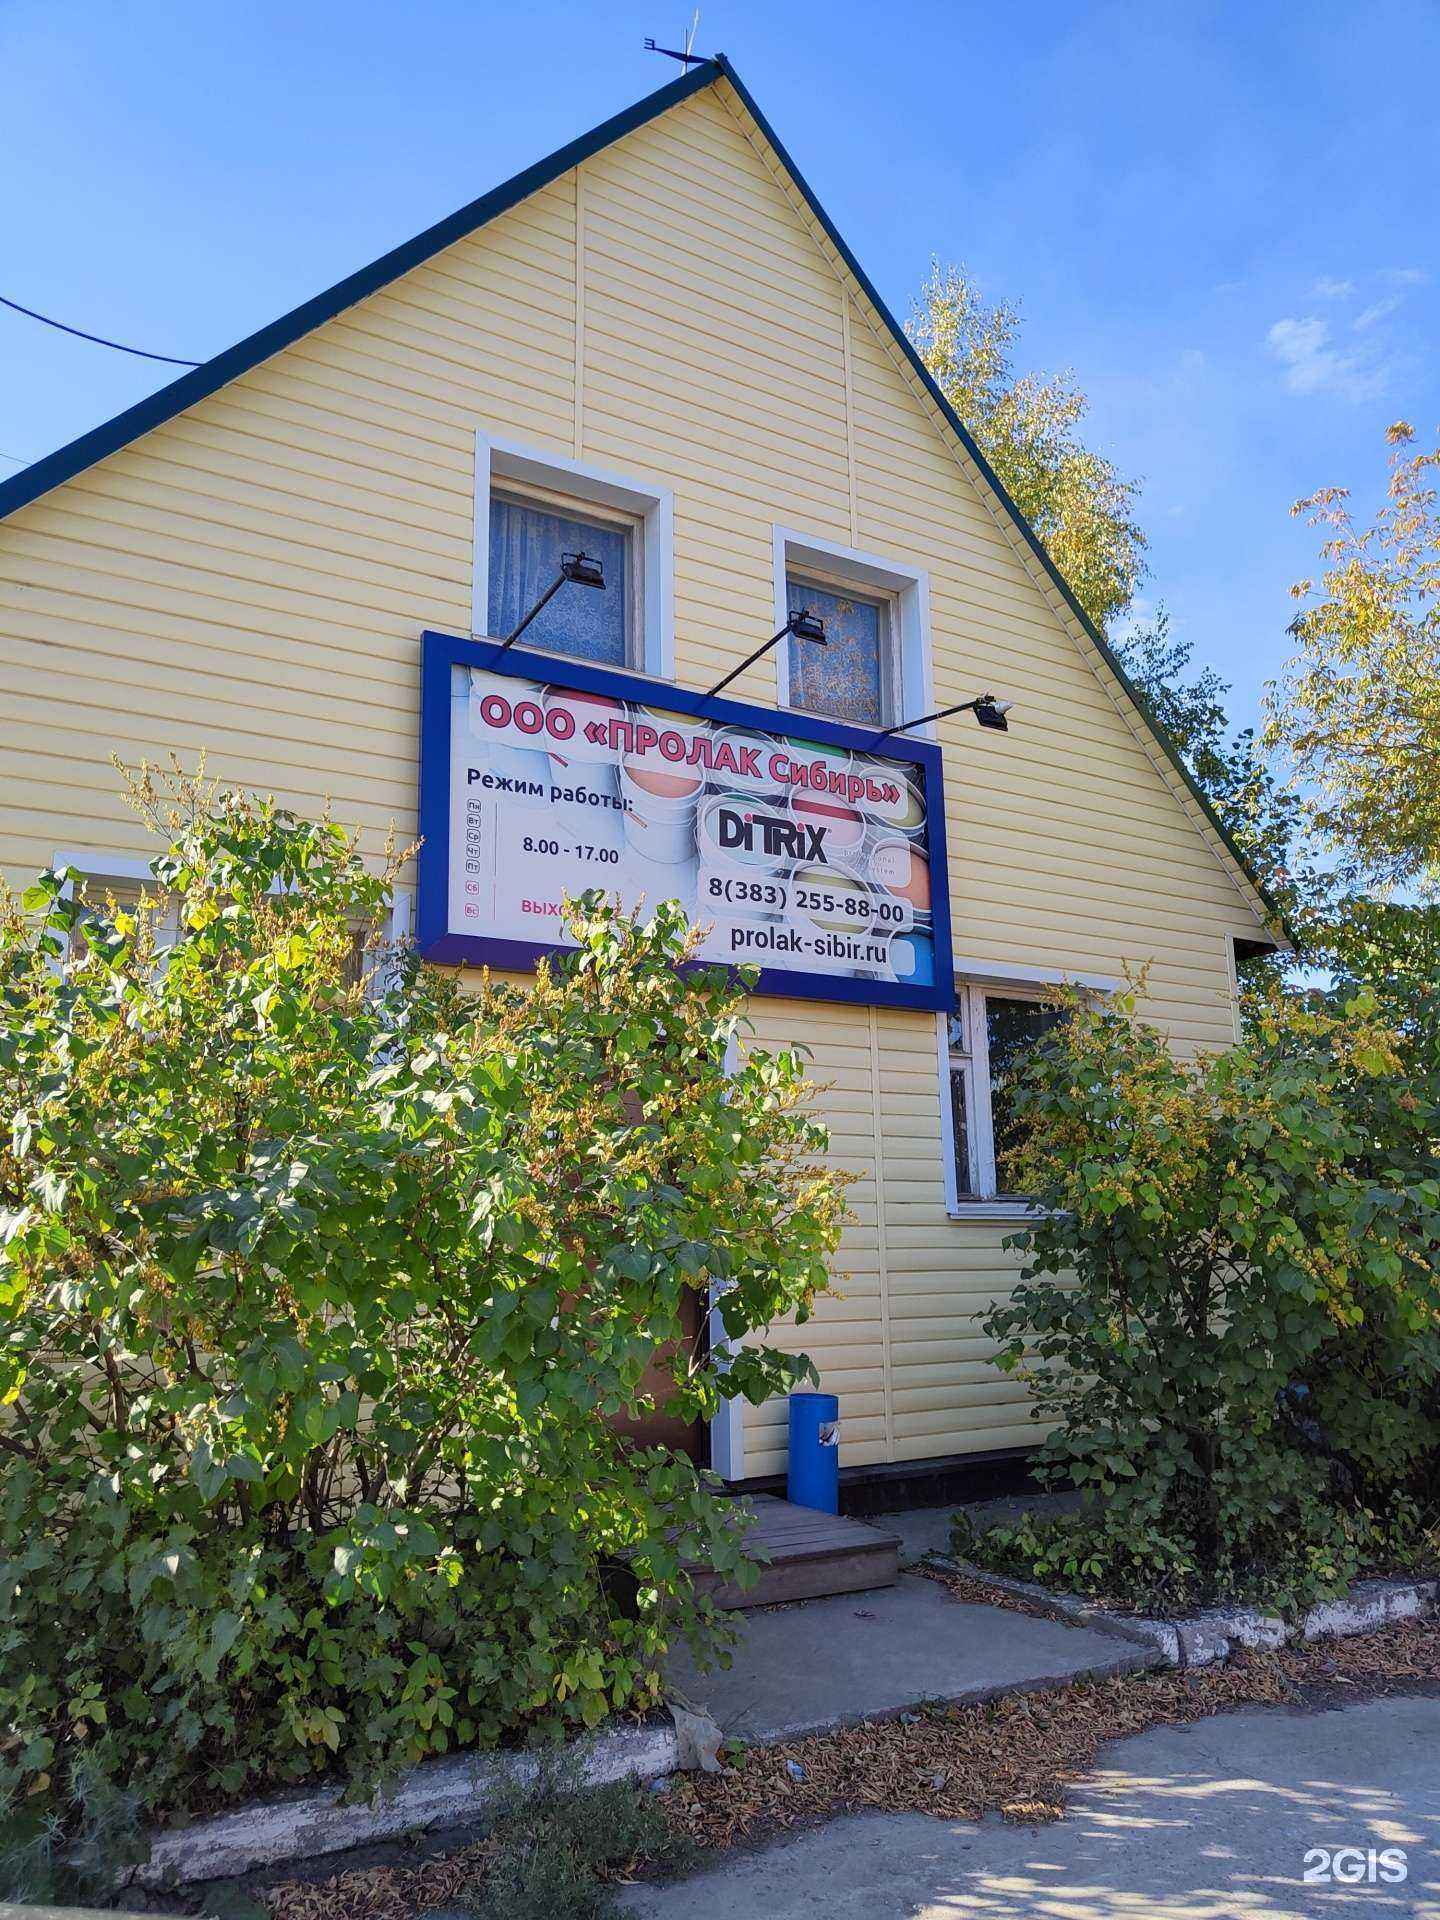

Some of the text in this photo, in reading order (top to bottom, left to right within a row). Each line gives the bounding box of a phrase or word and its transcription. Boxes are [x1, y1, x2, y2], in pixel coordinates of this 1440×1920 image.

[479, 693, 901, 806] ООО «ПРОЛАК Сибирь»
[467, 767, 633, 812] Режим работы:
[522, 836, 559, 856] 8.00
[575, 845, 619, 864] 17.00
[708, 877, 904, 923] 8(383) 255-88-00
[730, 925, 888, 964] prolak-sibir.ru
